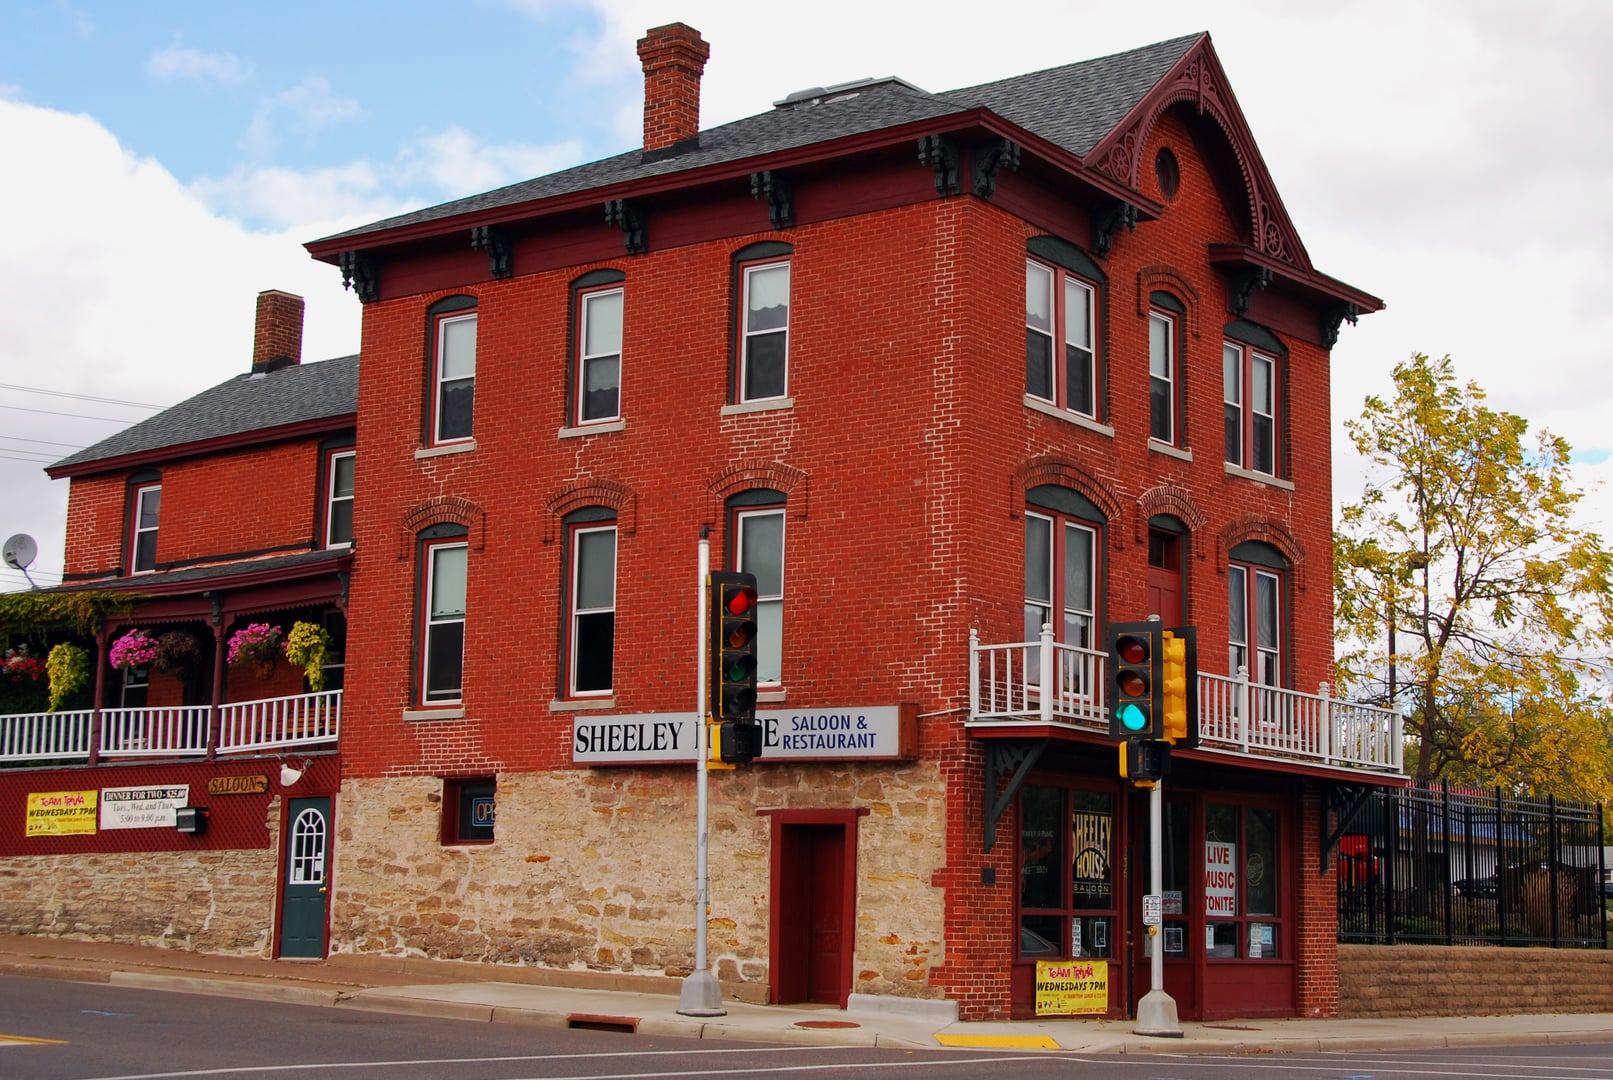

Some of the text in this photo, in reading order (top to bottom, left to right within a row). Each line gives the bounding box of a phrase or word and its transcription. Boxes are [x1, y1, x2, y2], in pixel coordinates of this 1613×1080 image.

[791, 715, 868, 731] SALOON &
[576, 721, 684, 753] SHEELEY
[783, 733, 877, 750] RESTAURANT
[211, 777, 257, 793] SALOON
[105, 791, 131, 801] DINNER
[132, 791, 146, 800] FOR
[146, 790, 163, 799] TWO
[29, 807, 96, 817] WEDNESDAYS 7PM
[477, 803, 496, 821] OPE
[1207, 846, 1230, 865] LIVE
[1077, 850, 1105, 879] HOUSE
[1205, 870, 1235, 889] MUSIC
[1073, 883, 1109, 893] SALOON
[1037, 981, 1106, 991] WEDNESDAYS 7PM
